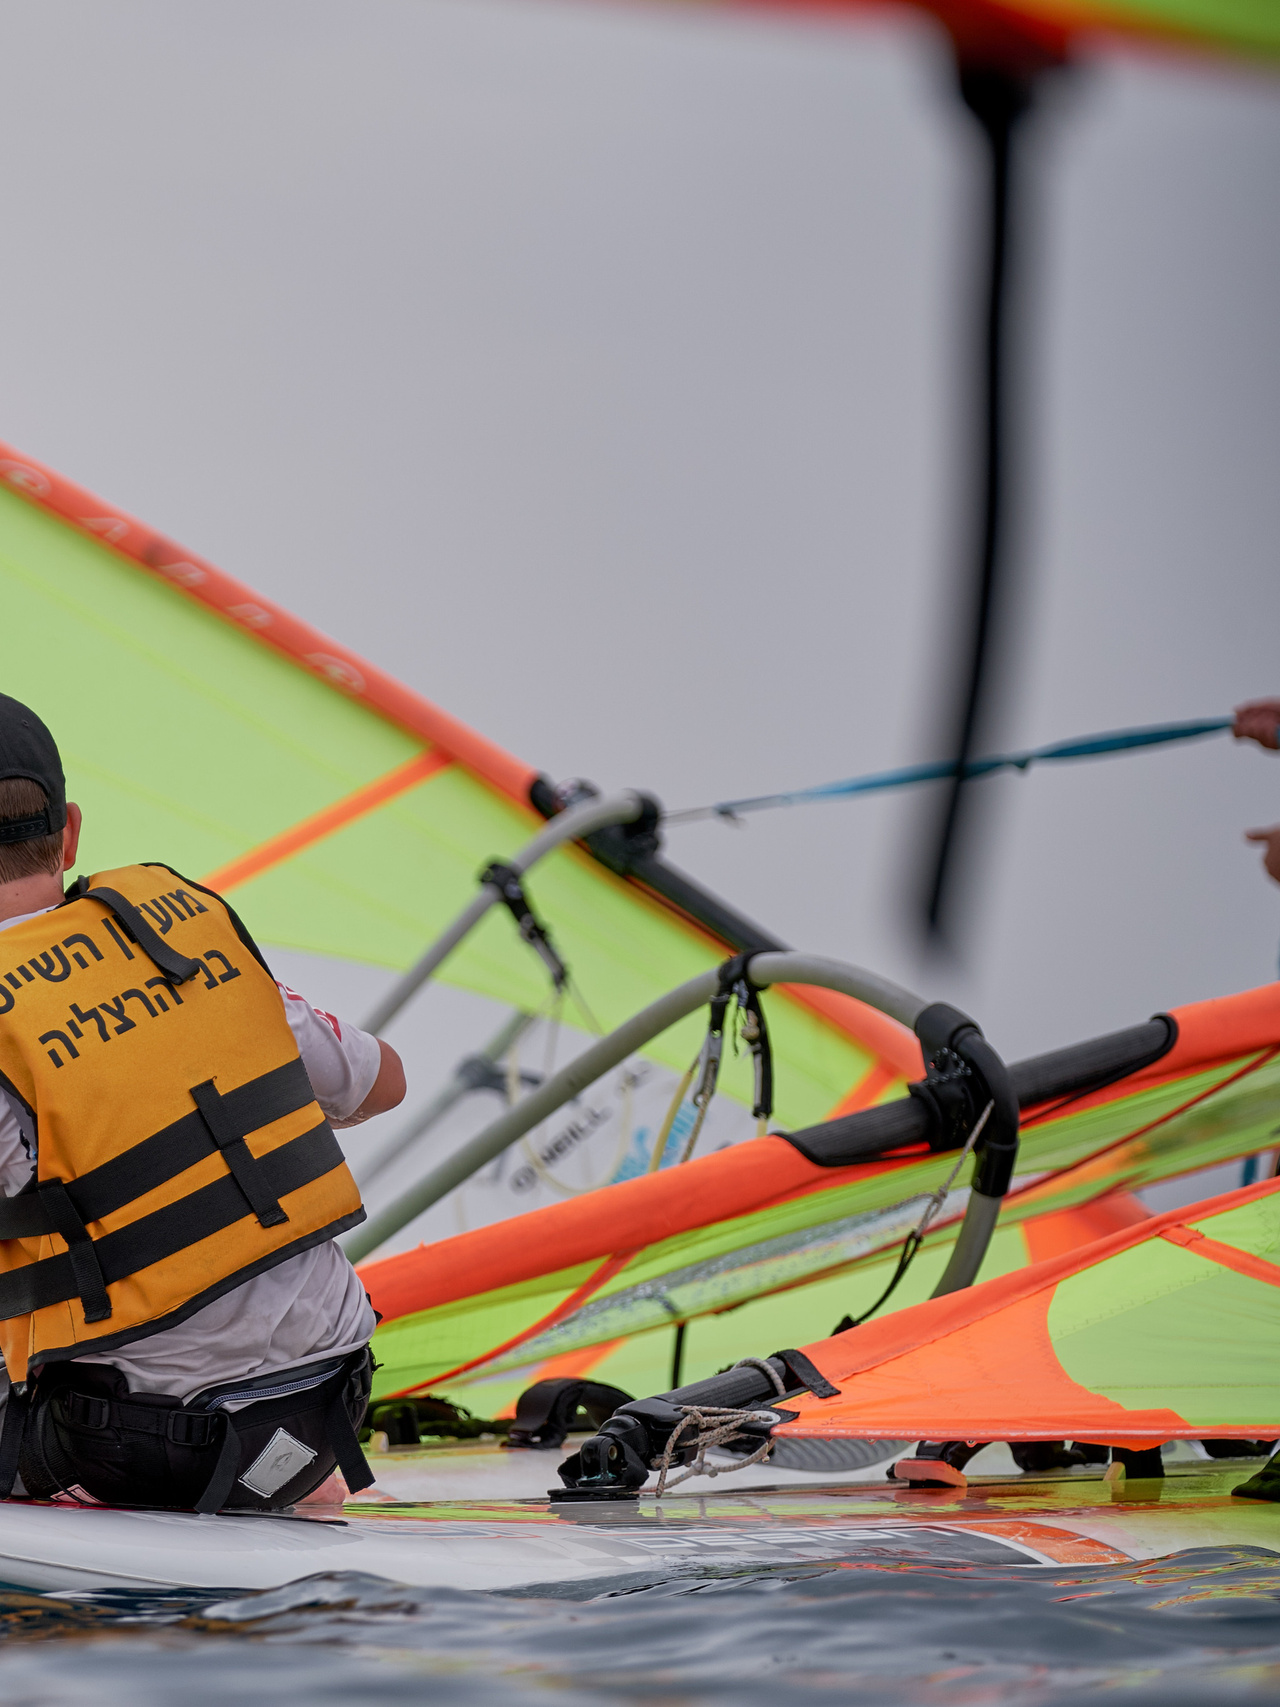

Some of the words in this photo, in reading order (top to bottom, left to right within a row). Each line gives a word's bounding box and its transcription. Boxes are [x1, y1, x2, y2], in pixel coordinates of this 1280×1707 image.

[101, 889, 208, 960] מועון
[189, 949, 241, 990] בנ
[38, 976, 184, 1069] הרצליה
[621, 1526, 960, 1549] DESIGN
